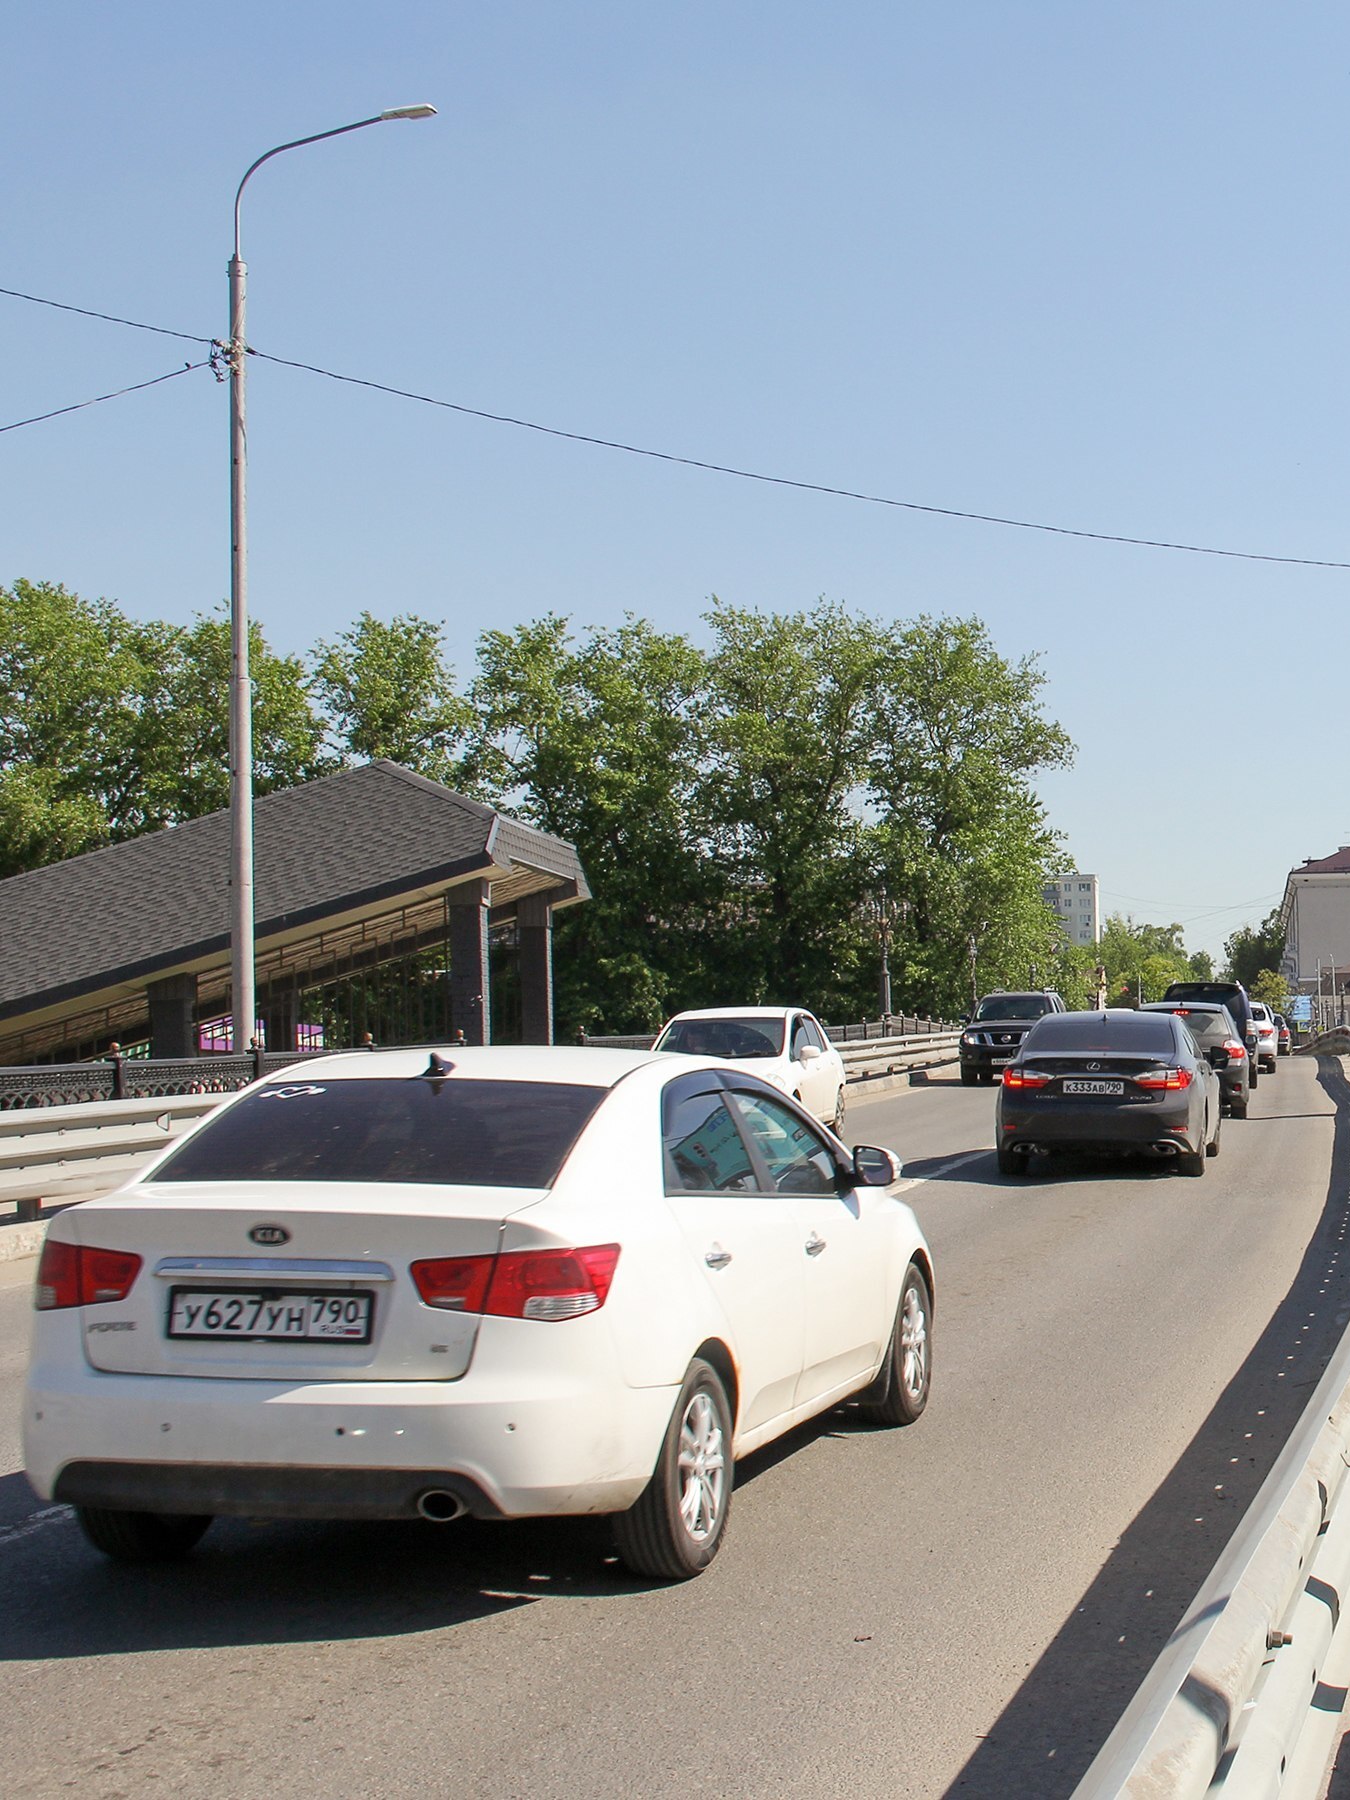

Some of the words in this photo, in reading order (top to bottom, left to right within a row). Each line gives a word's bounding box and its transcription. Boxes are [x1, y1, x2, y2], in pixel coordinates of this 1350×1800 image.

[1106, 1082, 1121, 1091] 790
[185, 1298, 305, 1332] У627УН
[312, 1298, 360, 1323] 790
